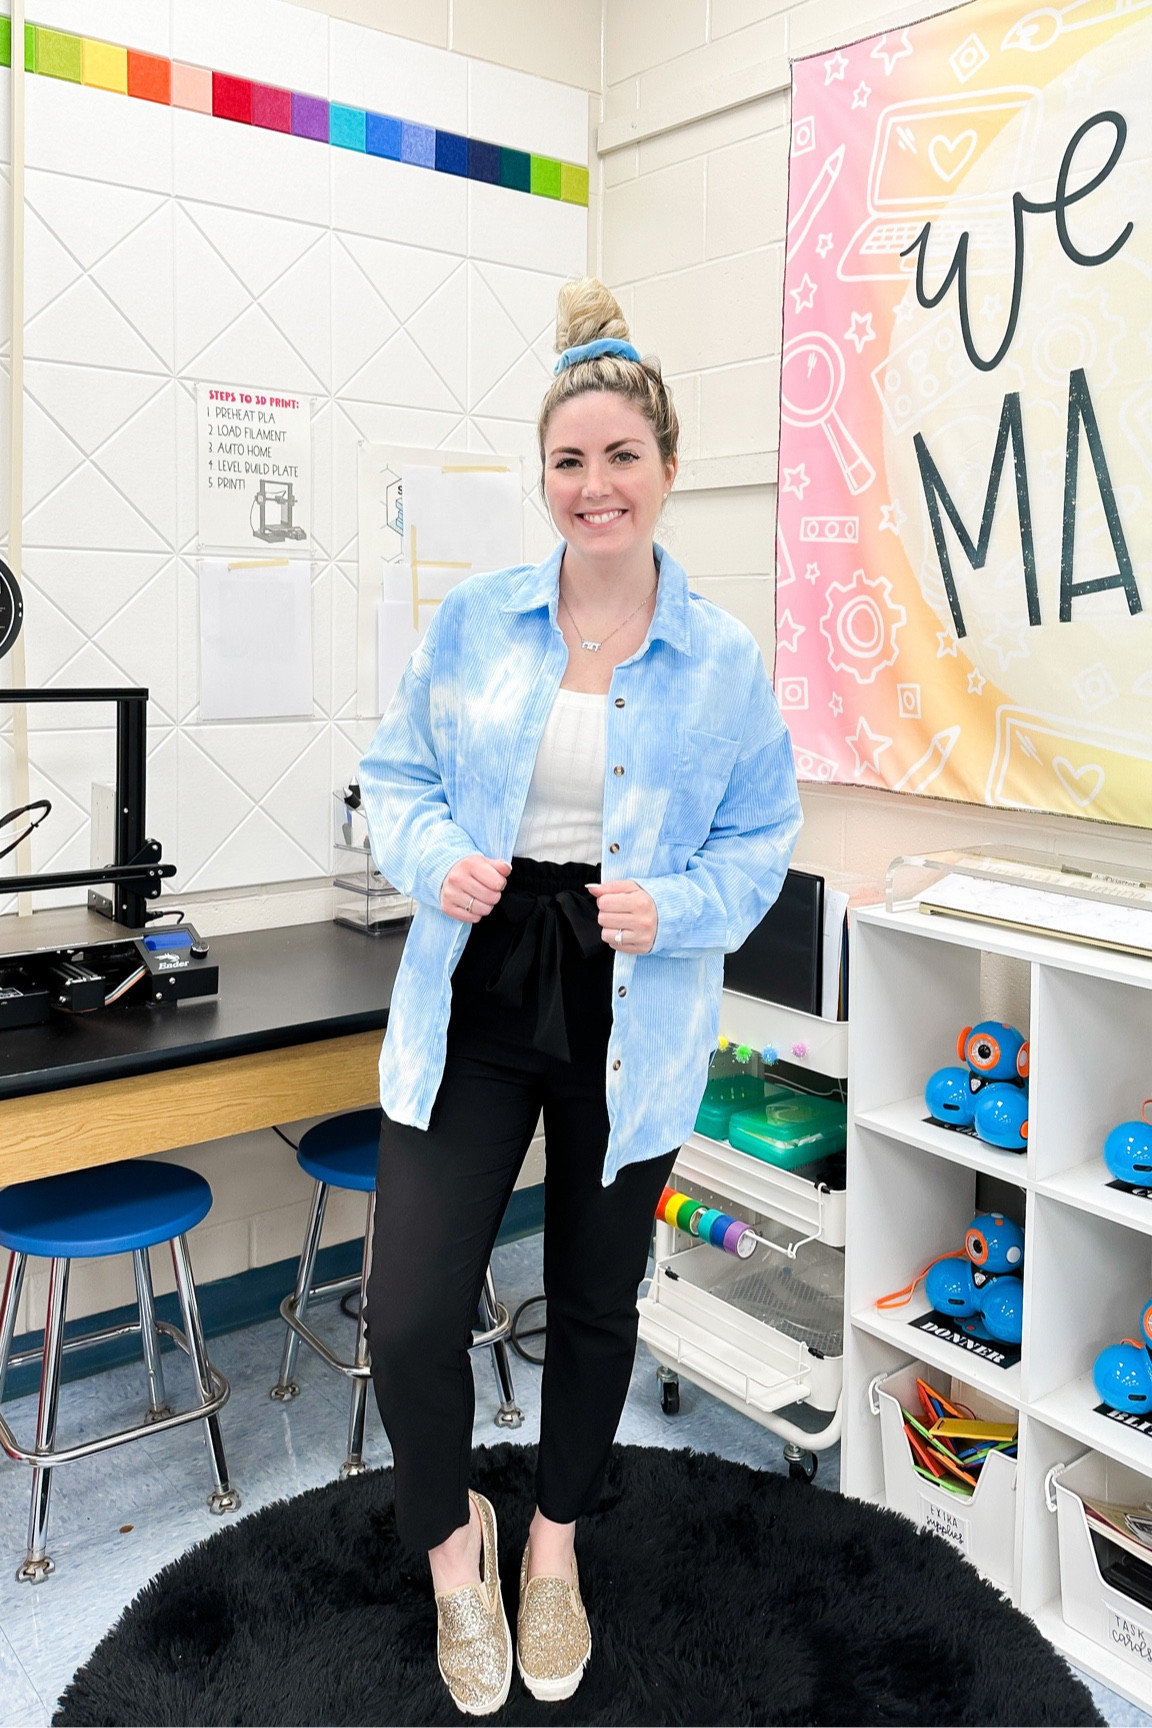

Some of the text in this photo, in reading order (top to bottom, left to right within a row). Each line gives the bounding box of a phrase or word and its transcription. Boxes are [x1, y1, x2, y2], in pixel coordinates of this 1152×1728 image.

[209, 390, 299, 409] STEPS TO 3D PRINT:
[215, 406, 255, 422] PREHEAT
[258, 411, 275, 424] PLA
[217, 424, 242, 438] LOAD
[244, 426, 287, 442] FILAMENT
[217, 442, 245, 456] AUTO
[247, 444, 272, 458] HOME
[217, 460, 242, 474] LEVEL
[244, 461, 270, 475] BUILD
[272, 464, 298, 478] PLATE
[159, 961, 189, 970] Ender
[920, 1321, 1005, 1364] DONNER
[930, 1504, 958, 1528] EXTRA
[926, 1515, 964, 1544] supplies
[1115, 1614, 1145, 1641] TASK
